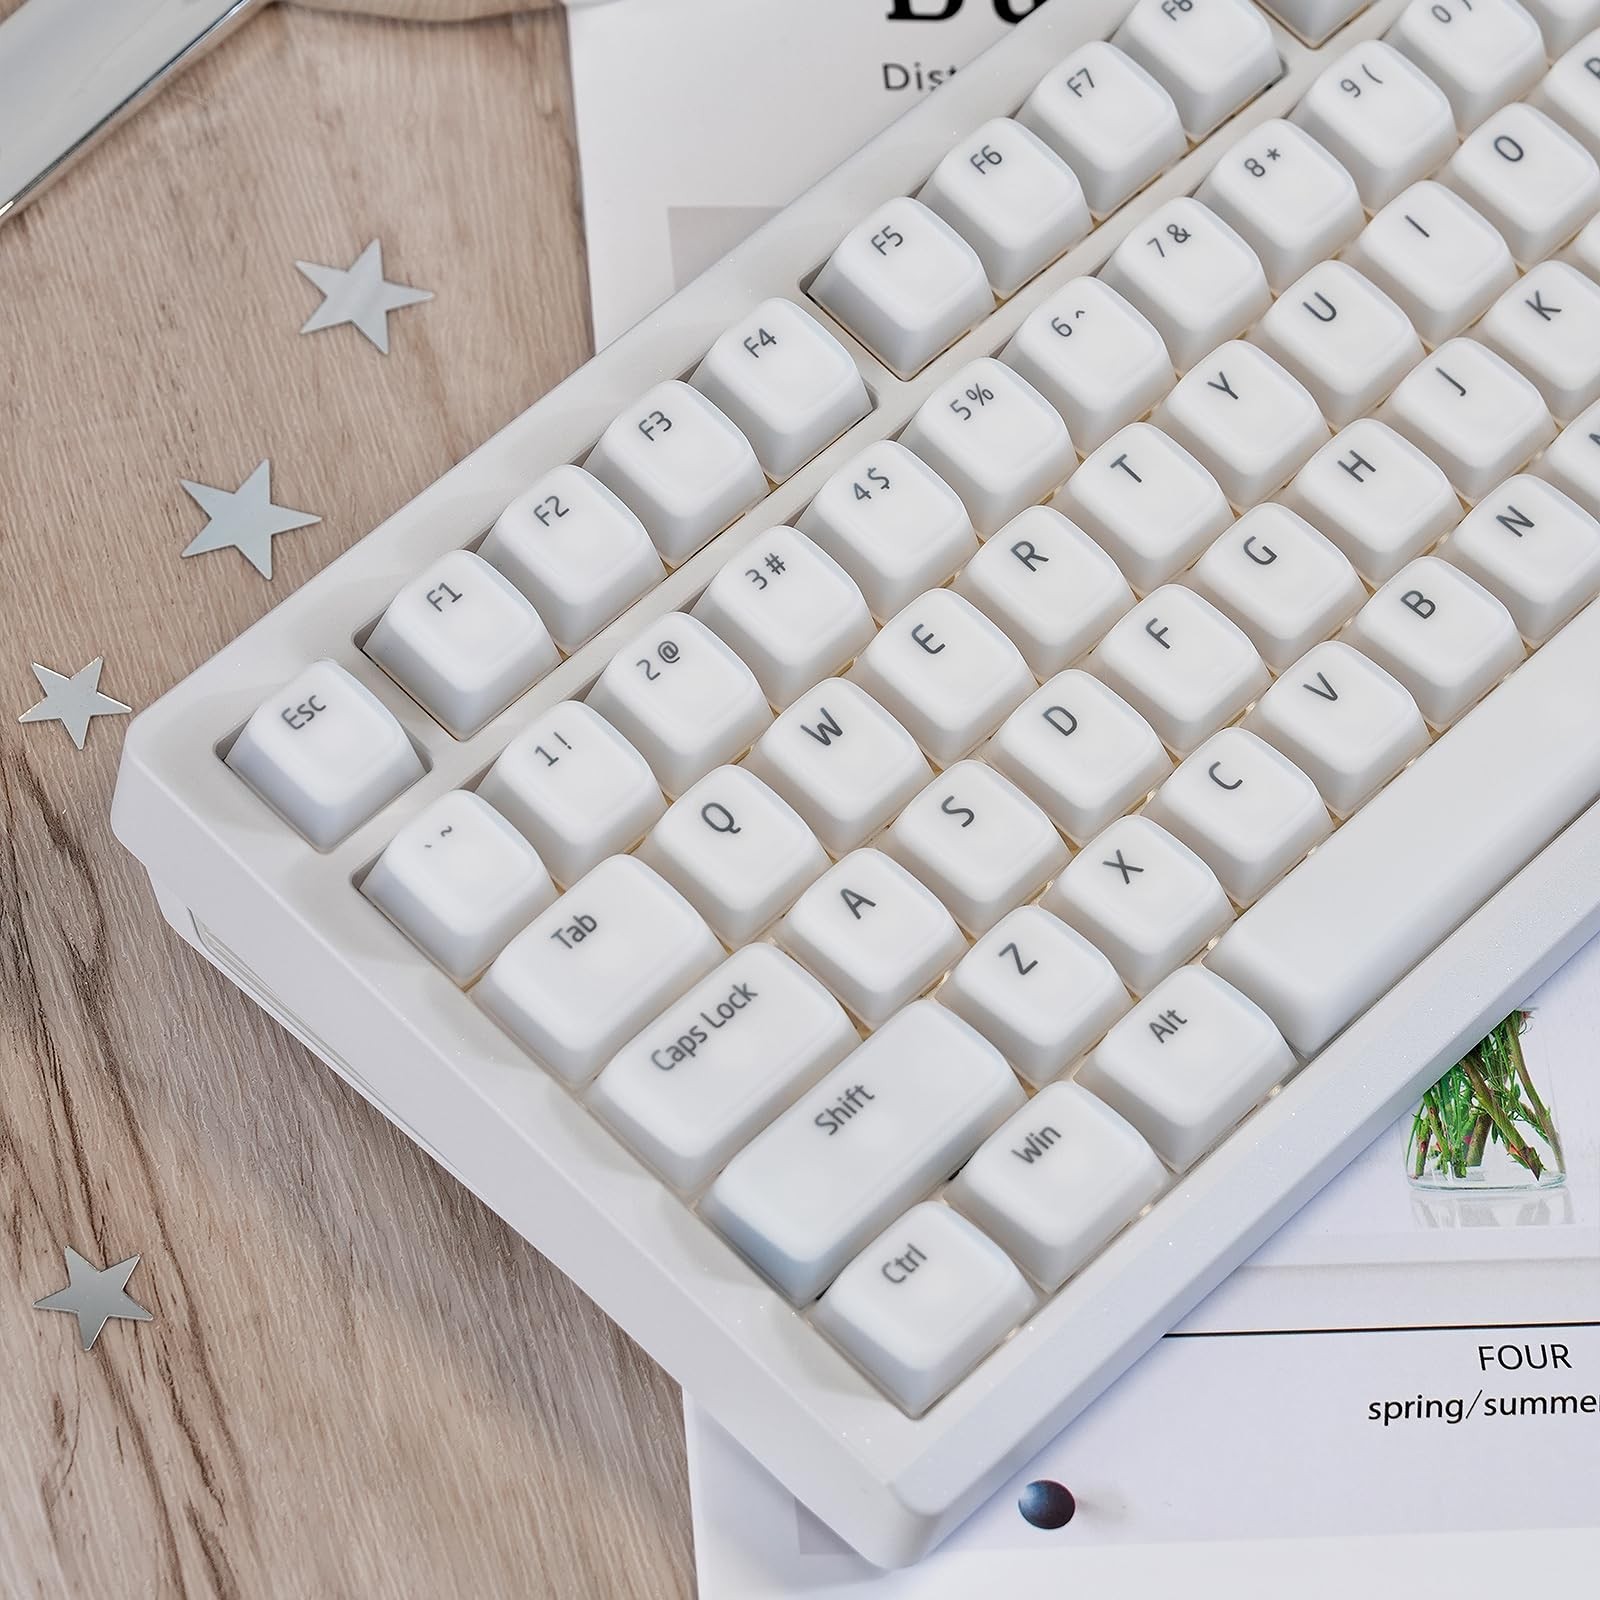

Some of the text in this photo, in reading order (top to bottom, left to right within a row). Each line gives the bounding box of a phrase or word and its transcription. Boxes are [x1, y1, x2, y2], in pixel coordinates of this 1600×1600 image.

[1161, 0, 1194, 21] F8
[1431, 5, 1452, 24] 0
[1067, 68, 1095, 98] F7
[1340, 64, 1383, 98] 9 (
[970, 145, 1003, 175] F6
[1493, 135, 1524, 163] O
[1244, 158, 1266, 178] 8
[871, 225, 903, 256] F5
[1147, 224, 1192, 258] 7 &
[1405, 215, 1430, 238] I
[1302, 292, 1337, 322] U
[1525, 290, 1562, 321] K
[1051, 317, 1072, 337] 6
[743, 328, 777, 358] F4
[1207, 371, 1239, 400] Y
[1436, 368, 1466, 397] J
[950, 383, 994, 421] 5 %
[638, 411, 672, 441] F3
[1110, 454, 1142, 483] T
[1337, 450, 1376, 483] H
[853, 467, 890, 500] 4 $
[533, 496, 569, 527] F2
[1496, 505, 1535, 537] N
[1010, 541, 1049, 572] R
[1243, 536, 1277, 565] G
[745, 553, 786, 590] 3 #
[426, 583, 463, 612] F1
[1400, 590, 1436, 619] B
[911, 624, 945, 654] E
[1145, 618, 1170, 649] F
[636, 641, 680, 681] 2 @
[1302, 672, 1338, 701] V
[281, 695, 326, 730] Esc
[800, 707, 843, 746] W
[1042, 706, 1077, 736] D
[535, 732, 572, 767] 1 !
[1208, 761, 1243, 790] C
[701, 802, 742, 834] Q
[941, 795, 975, 828] S
[1102, 849, 1144, 885] X
[840, 888, 876, 920] A
[550, 915, 597, 949] Tab
[998, 942, 1038, 975] Z
[651, 983, 758, 1071] Caps Lock
[1149, 1010, 1188, 1044] Alt
[814, 1085, 875, 1136] Shift
[1011, 1126, 1062, 1164] Win
[881, 1243, 927, 1284] Ctrl
[1478, 1344, 1572, 1371] FOUR
[1368, 1389, 1600, 1426] spring/summe
